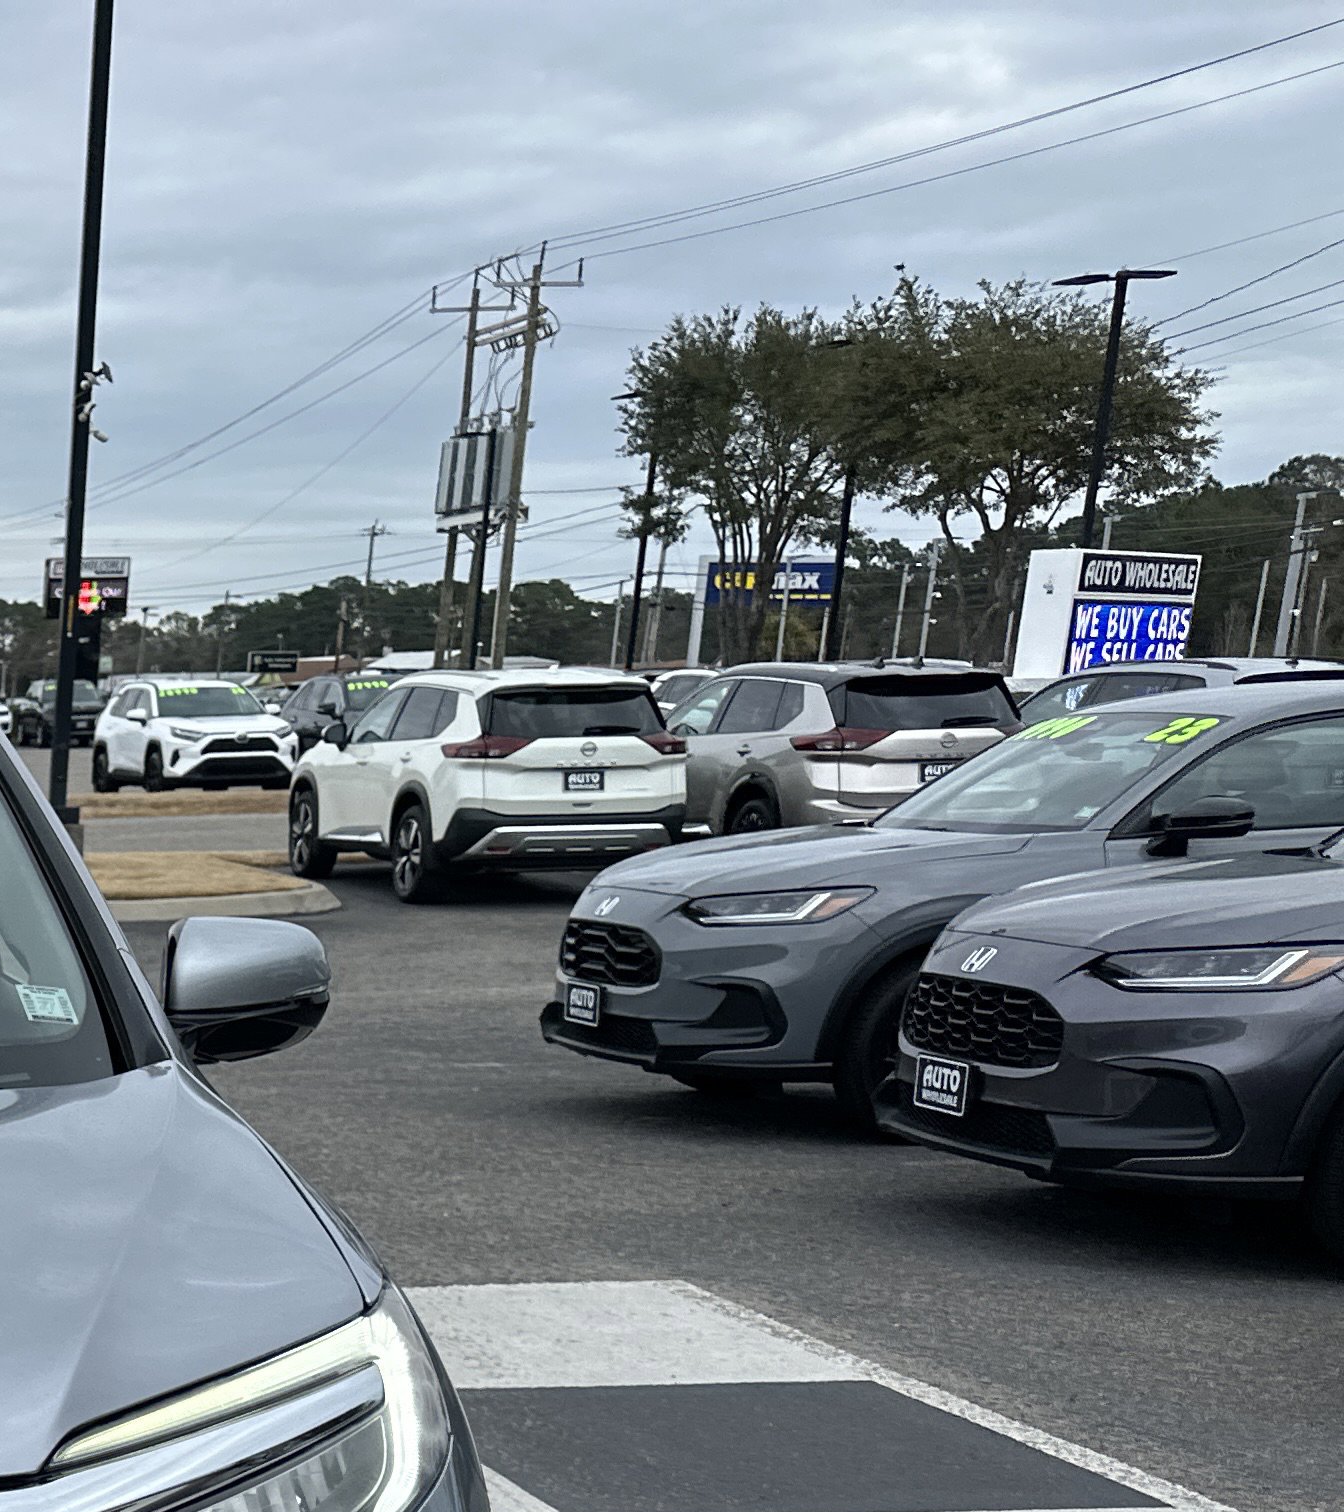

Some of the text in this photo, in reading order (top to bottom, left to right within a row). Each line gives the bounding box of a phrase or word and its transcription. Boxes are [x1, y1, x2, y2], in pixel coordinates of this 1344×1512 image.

[1085, 560, 1196, 590] AUTO WHOLESALE
[1075, 604, 1190, 640] WE BUY CARS
[1143, 717, 1220, 745] 23
[568, 772, 601, 784] AUTO
[923, 1065, 961, 1093] AUTO
